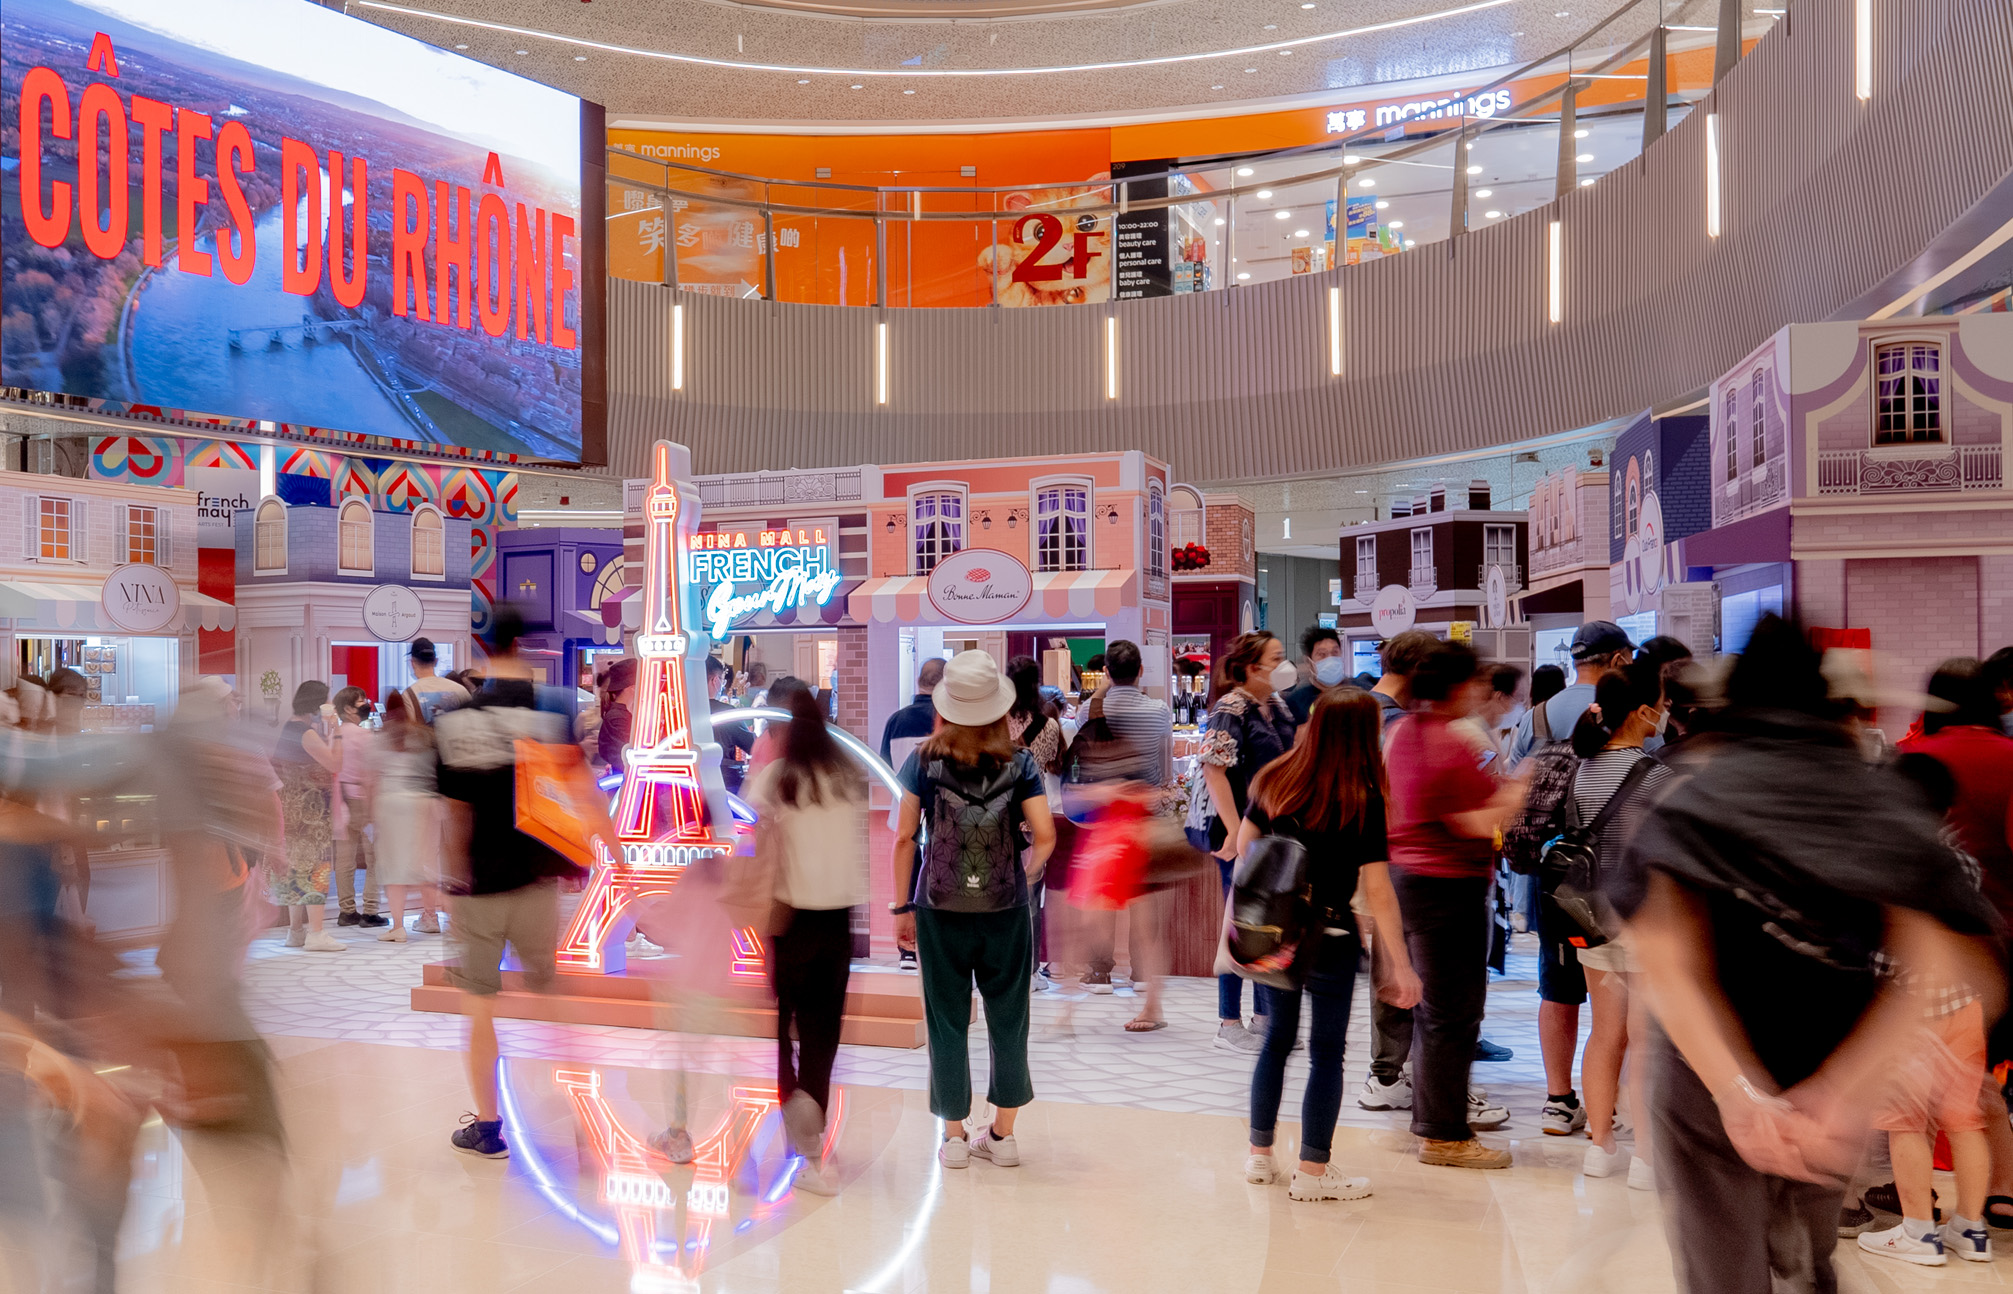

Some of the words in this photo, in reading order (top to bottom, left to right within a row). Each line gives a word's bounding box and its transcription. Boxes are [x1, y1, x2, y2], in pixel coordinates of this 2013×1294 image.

[1376, 89, 1512, 126] mannings
[641, 144, 720, 162] mannings
[20, 32, 256, 285] CÔTES
[281, 136, 368, 308] DU
[393, 151, 577, 350] RHÔNE
[1118, 221, 1159, 230] 10:00-22:00
[1012, 213, 1105, 282] 2F
[1119, 258, 1147, 268] personal
[1119, 279, 1135, 287] baby
[197, 491, 249, 508] french
[197, 508, 231, 527] may
[690, 532, 747, 549] NINA
[760, 529, 827, 546] MALL
[689, 545, 828, 584] FRENCH
[120, 582, 165, 604] NINA
[943, 584, 974, 600] Bonne
[976, 584, 1017, 600] Maman
